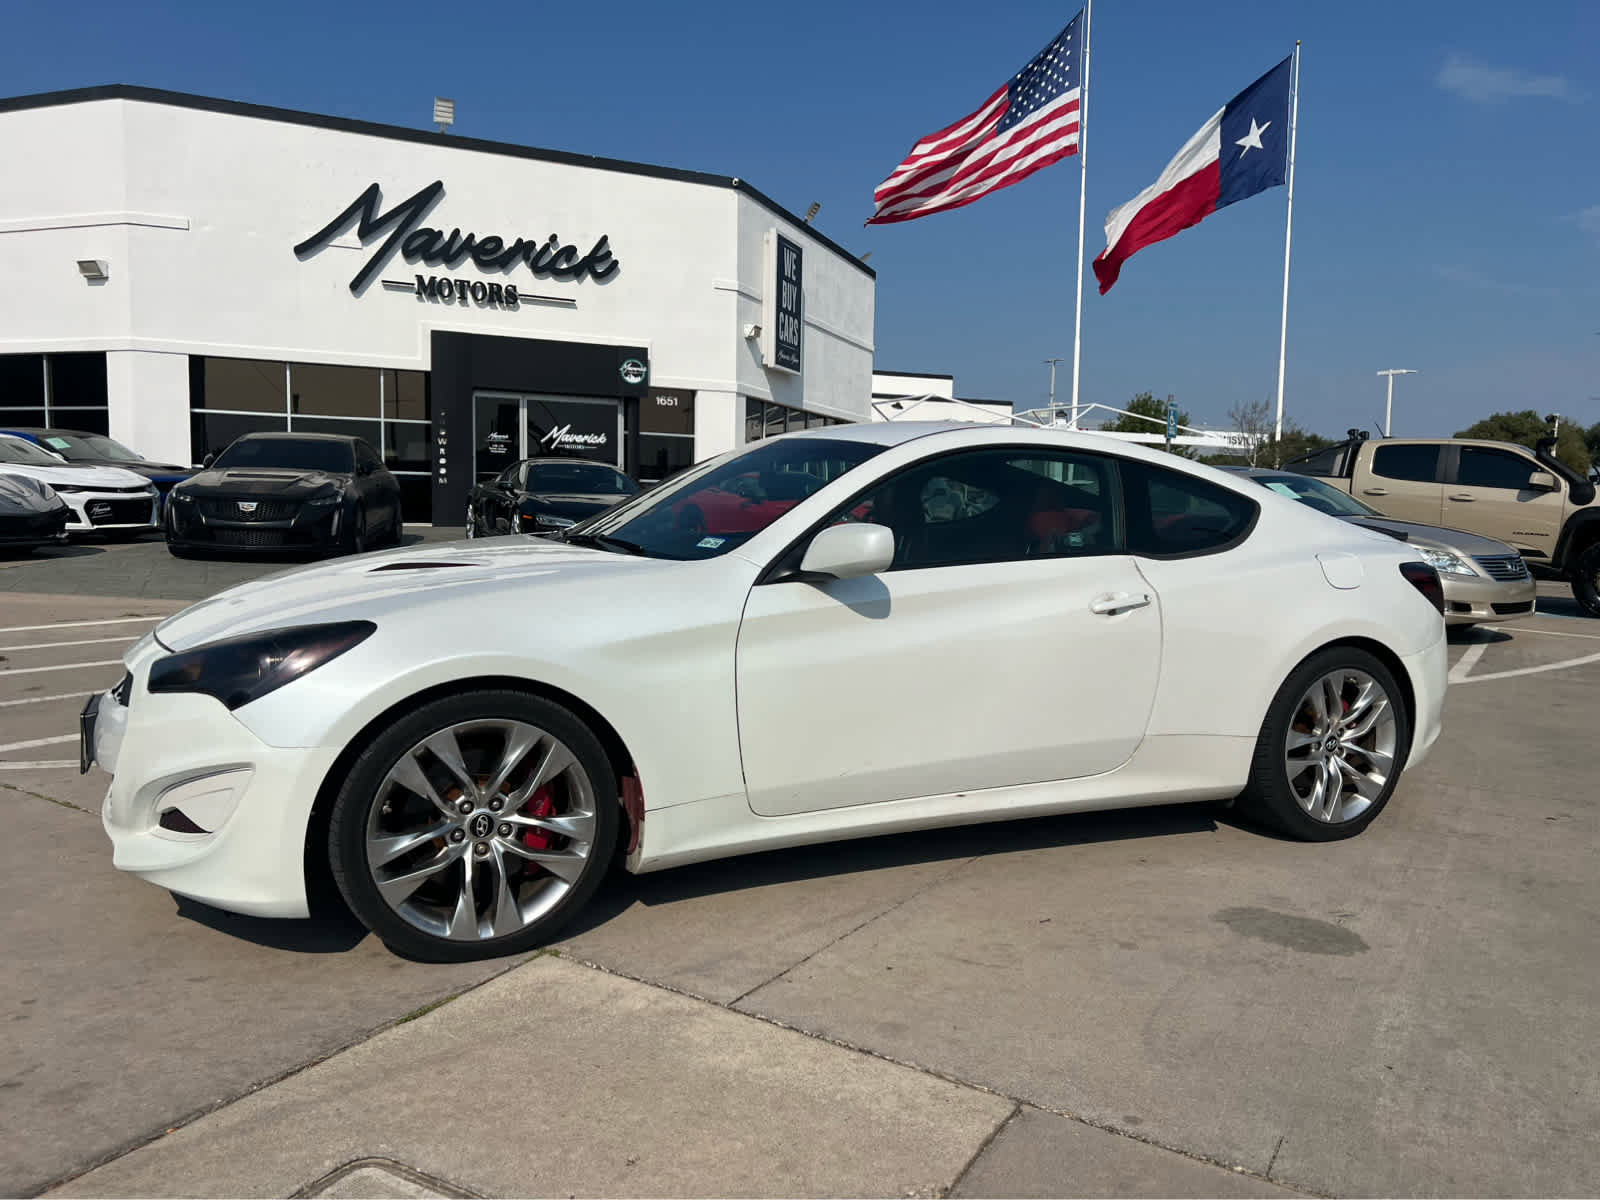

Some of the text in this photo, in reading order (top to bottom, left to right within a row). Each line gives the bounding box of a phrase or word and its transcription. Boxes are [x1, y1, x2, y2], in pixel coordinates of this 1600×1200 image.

[294, 180, 619, 296] Maverick
[783, 247, 797, 280] WE
[415, 275, 518, 305] MOTORS
[782, 280, 797, 313] BUY
[779, 311, 799, 346] CARS
[656, 396, 678, 406] 1651
[540, 424, 607, 450] Maverick
